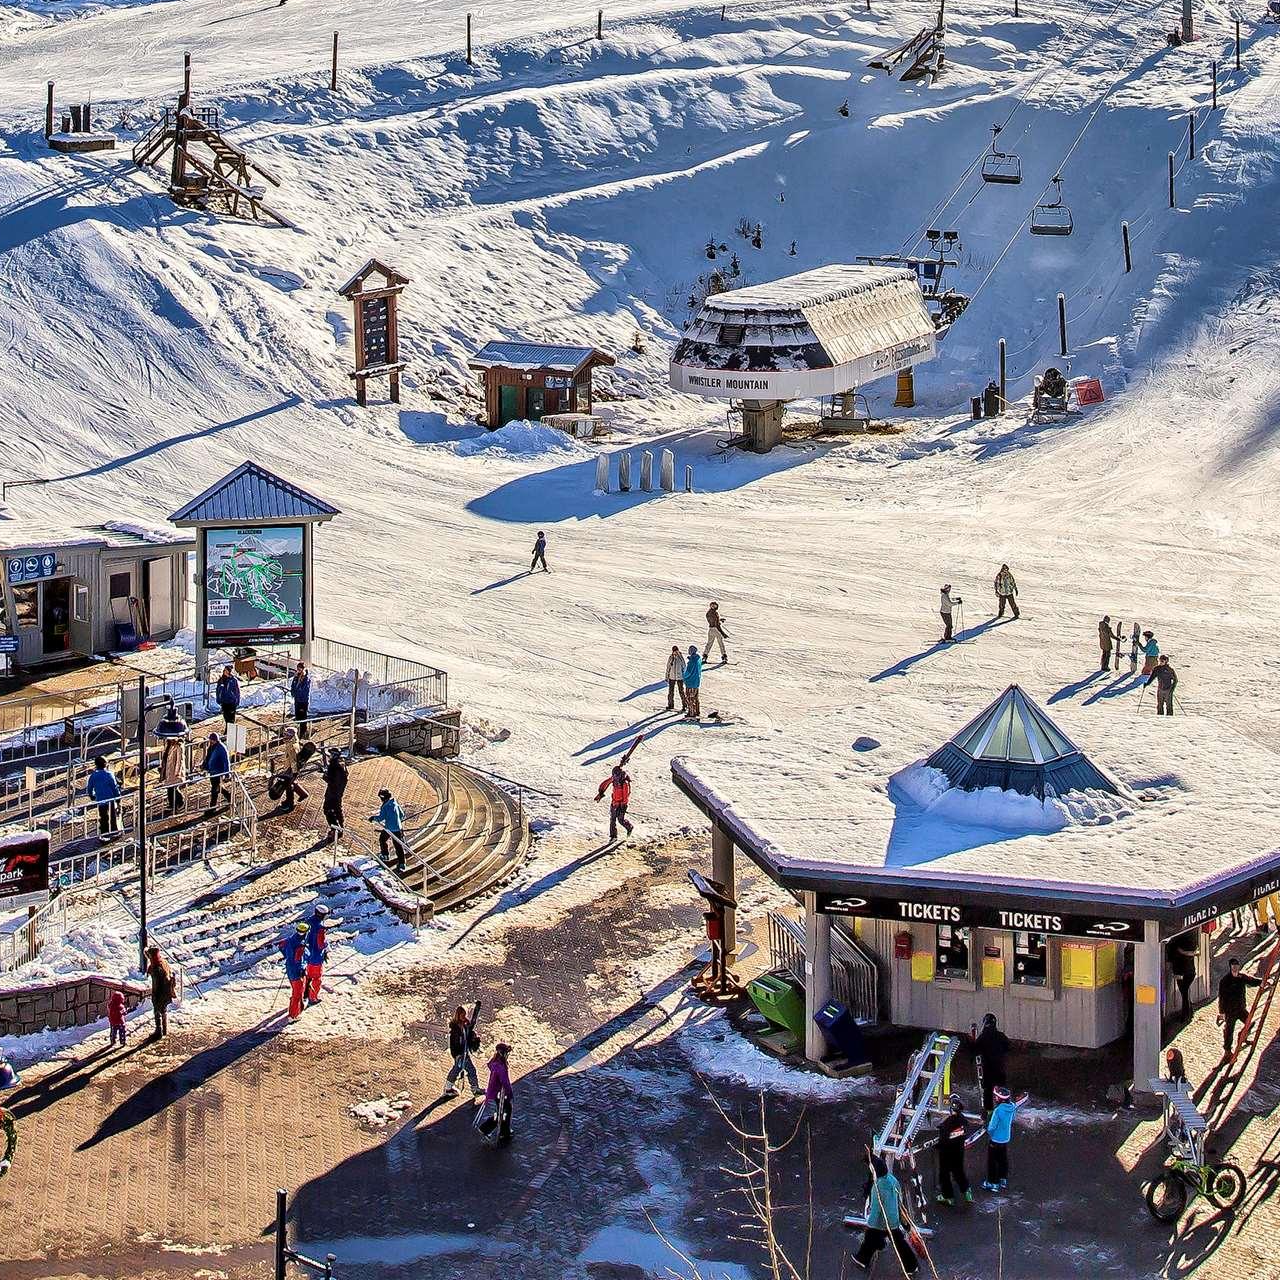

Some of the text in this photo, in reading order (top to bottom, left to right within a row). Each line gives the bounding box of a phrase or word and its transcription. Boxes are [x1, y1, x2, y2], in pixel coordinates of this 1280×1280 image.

[689, 375, 769, 390] WHISTLER MOUNTAIN
[0, 868, 24, 884] park
[898, 902, 961, 922] TICKETS
[998, 911, 1062, 931] TICKETS
